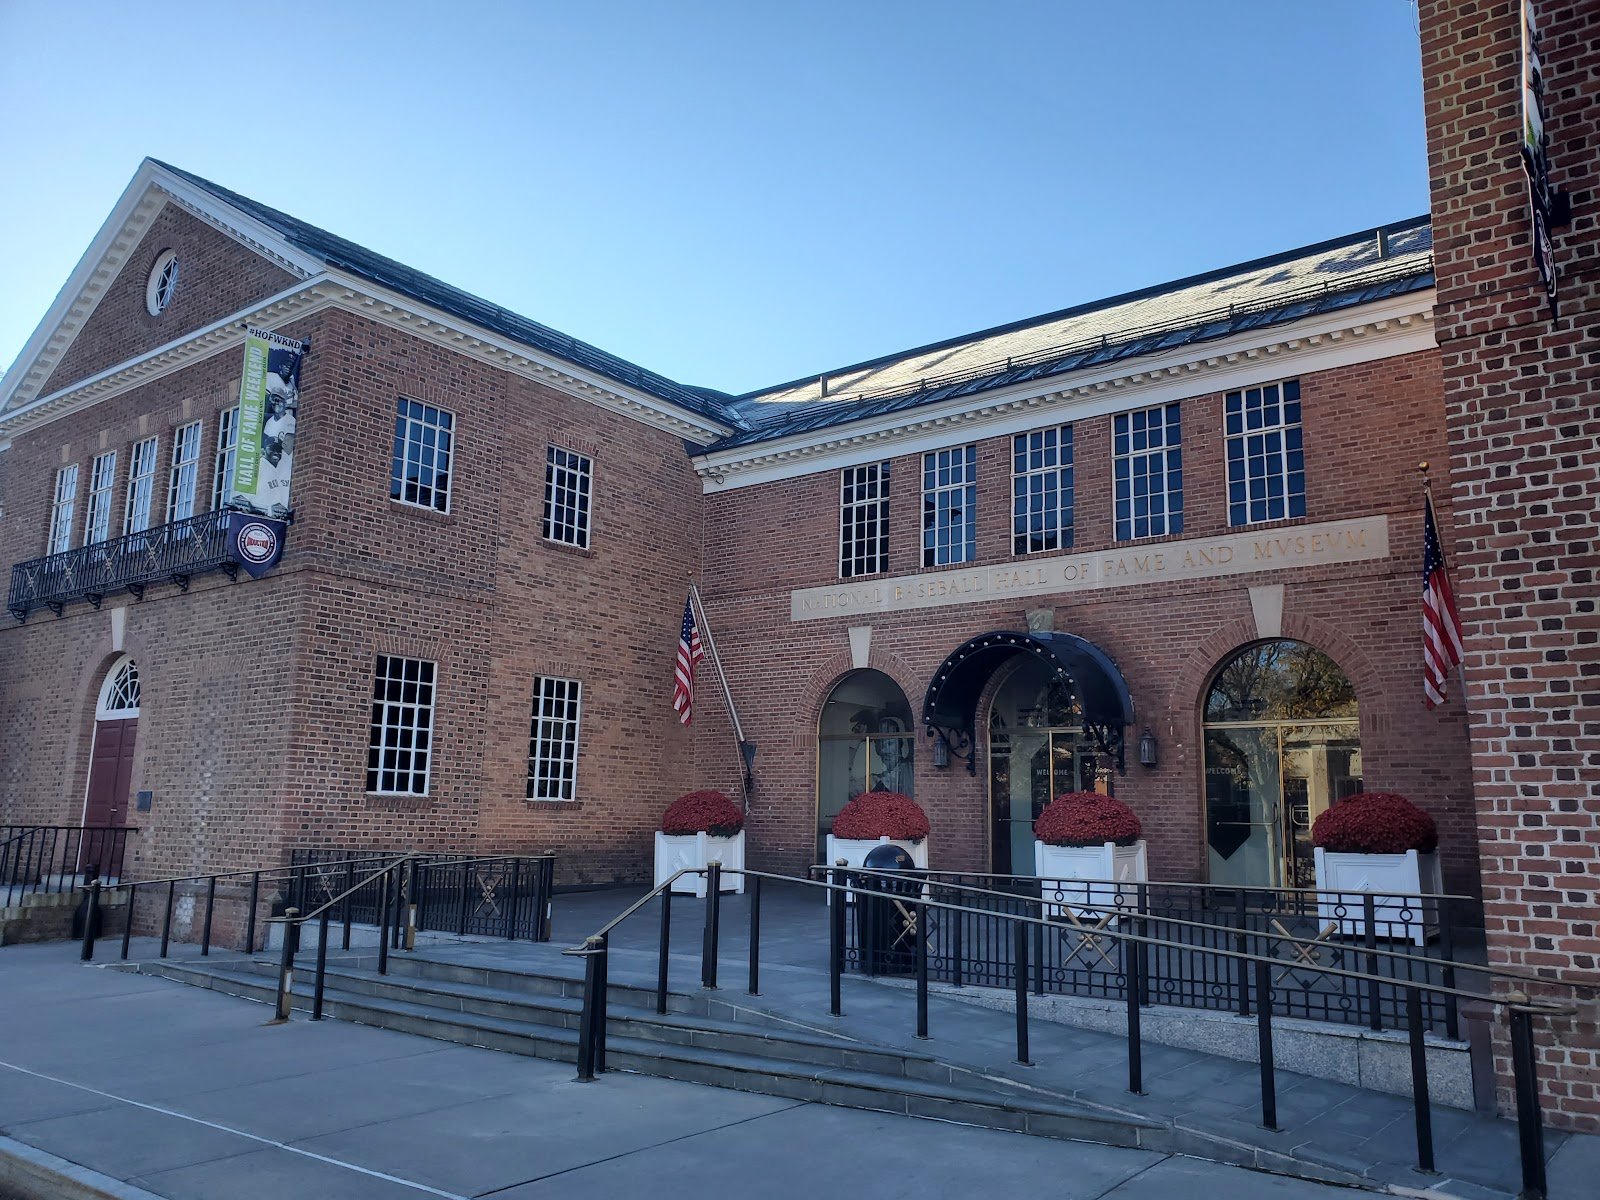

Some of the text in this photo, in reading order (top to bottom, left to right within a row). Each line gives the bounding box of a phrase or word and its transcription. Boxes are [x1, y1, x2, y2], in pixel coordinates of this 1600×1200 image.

[249, 328, 300, 349] #HOFWKND
[238, 346, 263, 486] HALL OF FAME WEEKEND
[802, 529, 1367, 611] NATIONAL BASEBALL HALL OF FAME AND MVSEVM
